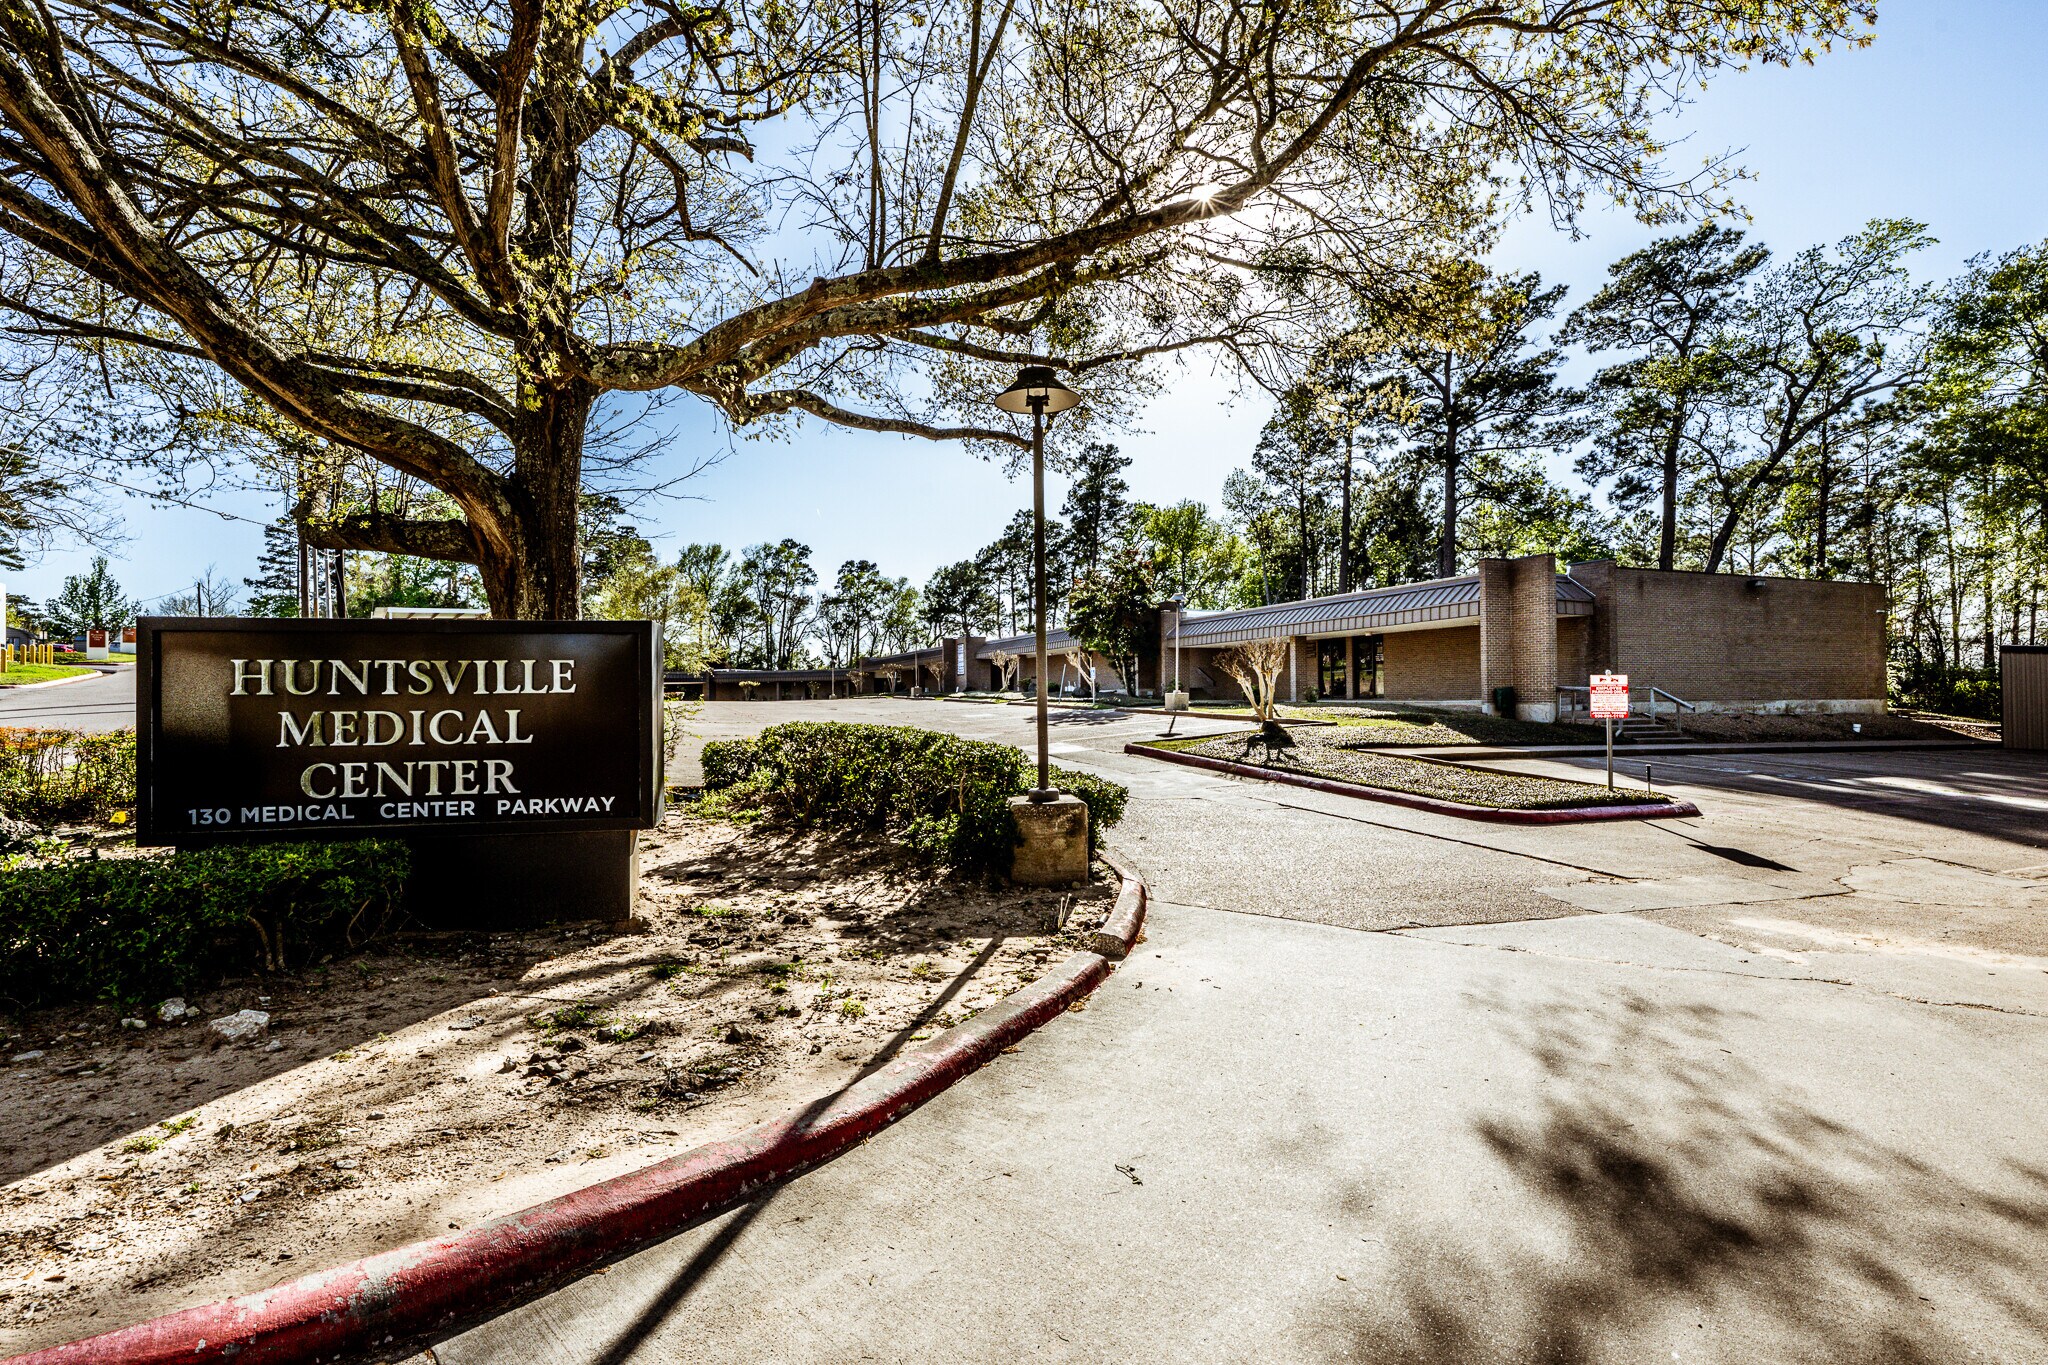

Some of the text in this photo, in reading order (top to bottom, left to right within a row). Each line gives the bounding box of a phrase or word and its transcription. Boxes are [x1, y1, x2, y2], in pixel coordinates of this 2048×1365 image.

[229, 659, 577, 696] HUNTSVILLE
[275, 709, 534, 748] MEDICAL
[300, 759, 521, 799] CENTER
[188, 796, 616, 825] 130 MEDICAL CENTER PARKWAY
